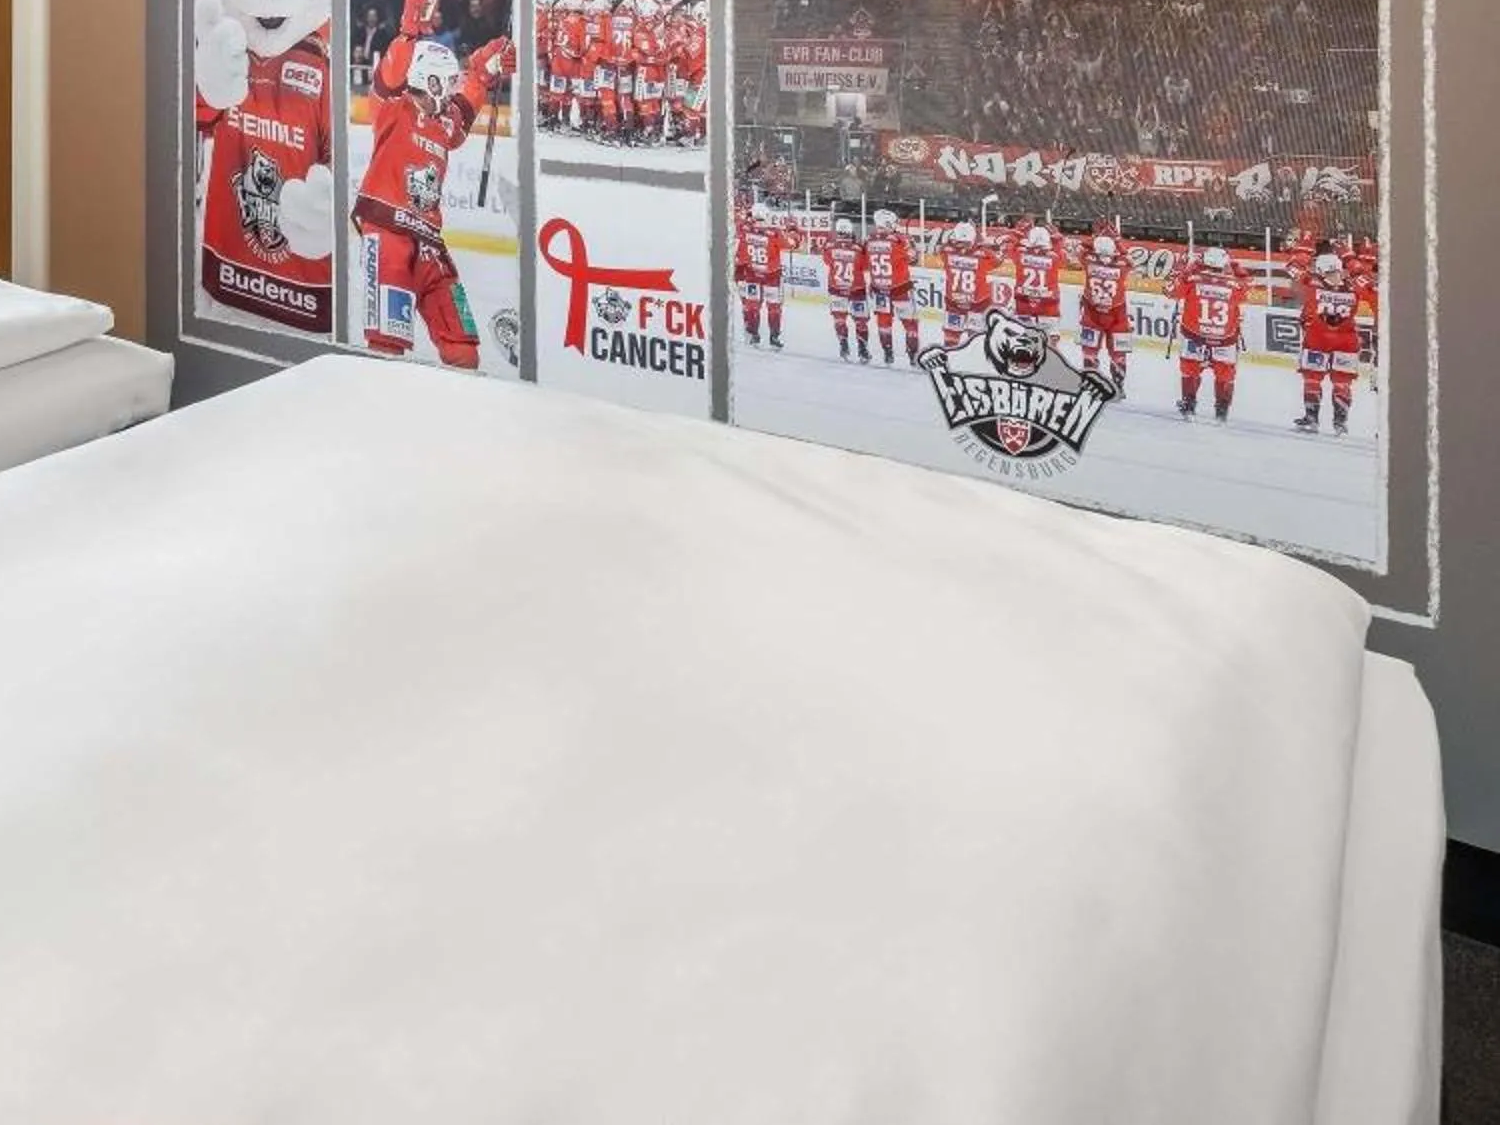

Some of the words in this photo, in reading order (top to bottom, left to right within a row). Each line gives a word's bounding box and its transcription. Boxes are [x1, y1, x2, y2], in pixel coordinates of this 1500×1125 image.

[219, 262, 318, 311] Buderus
[1022, 268, 1047, 294] 21
[1199, 298, 1230, 326] 13
[591, 327, 705, 380] CANCER
